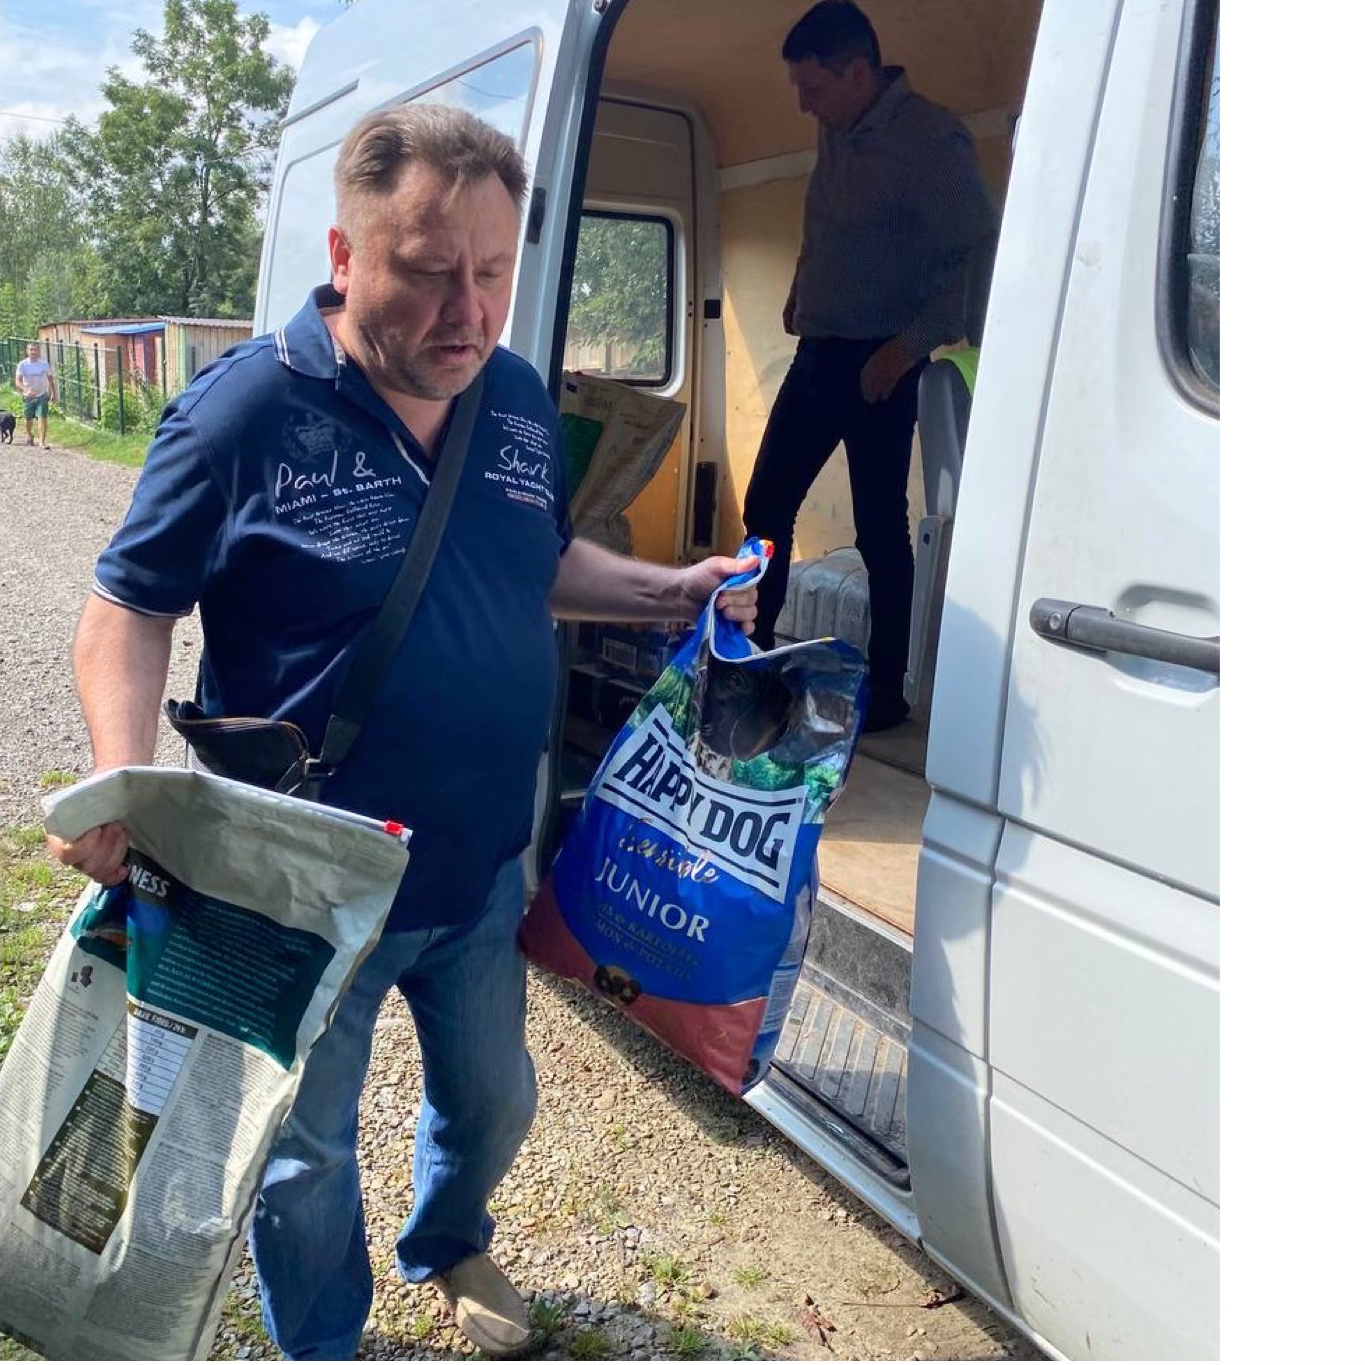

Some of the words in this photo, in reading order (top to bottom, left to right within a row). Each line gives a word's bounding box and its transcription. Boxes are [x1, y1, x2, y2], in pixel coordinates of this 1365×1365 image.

[275, 449, 338, 498] Paul
[352, 451, 377, 478] &
[497, 445, 551, 485] Shark
[274, 494, 317, 514] MIAMI
[355, 476, 402, 492] BARTH
[699, 799, 791, 871] DOG
[595, 857, 710, 942] JUNIOR
